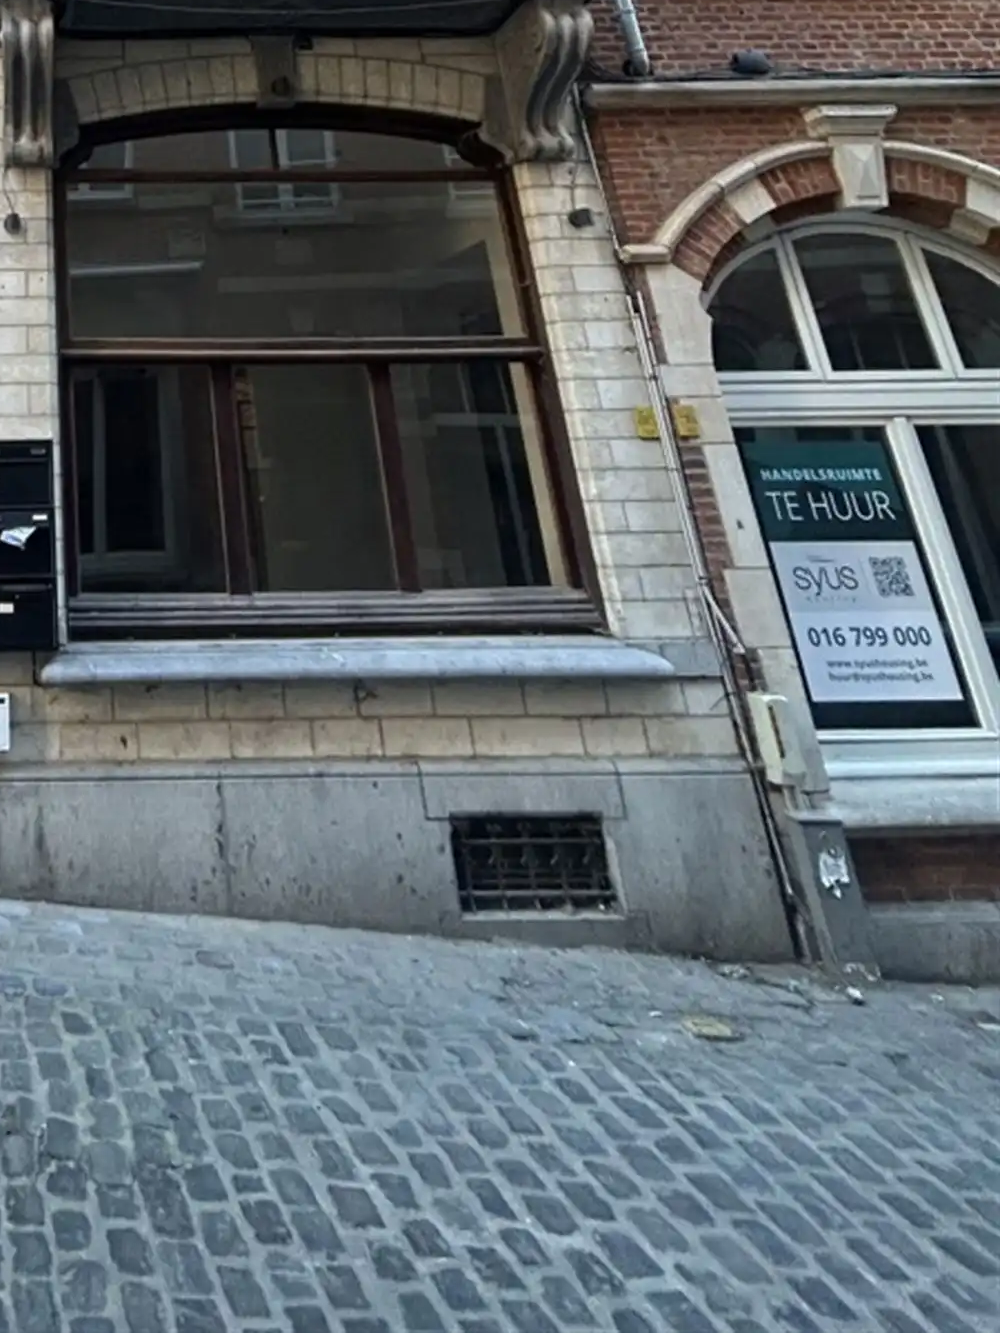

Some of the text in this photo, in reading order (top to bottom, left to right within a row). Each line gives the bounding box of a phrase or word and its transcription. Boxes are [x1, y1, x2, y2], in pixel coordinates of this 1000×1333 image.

[759, 467, 884, 481] HANDELSRUIMTE
[764, 490, 897, 521] TE HUUR
[807, 625, 933, 648] 016 799 000
